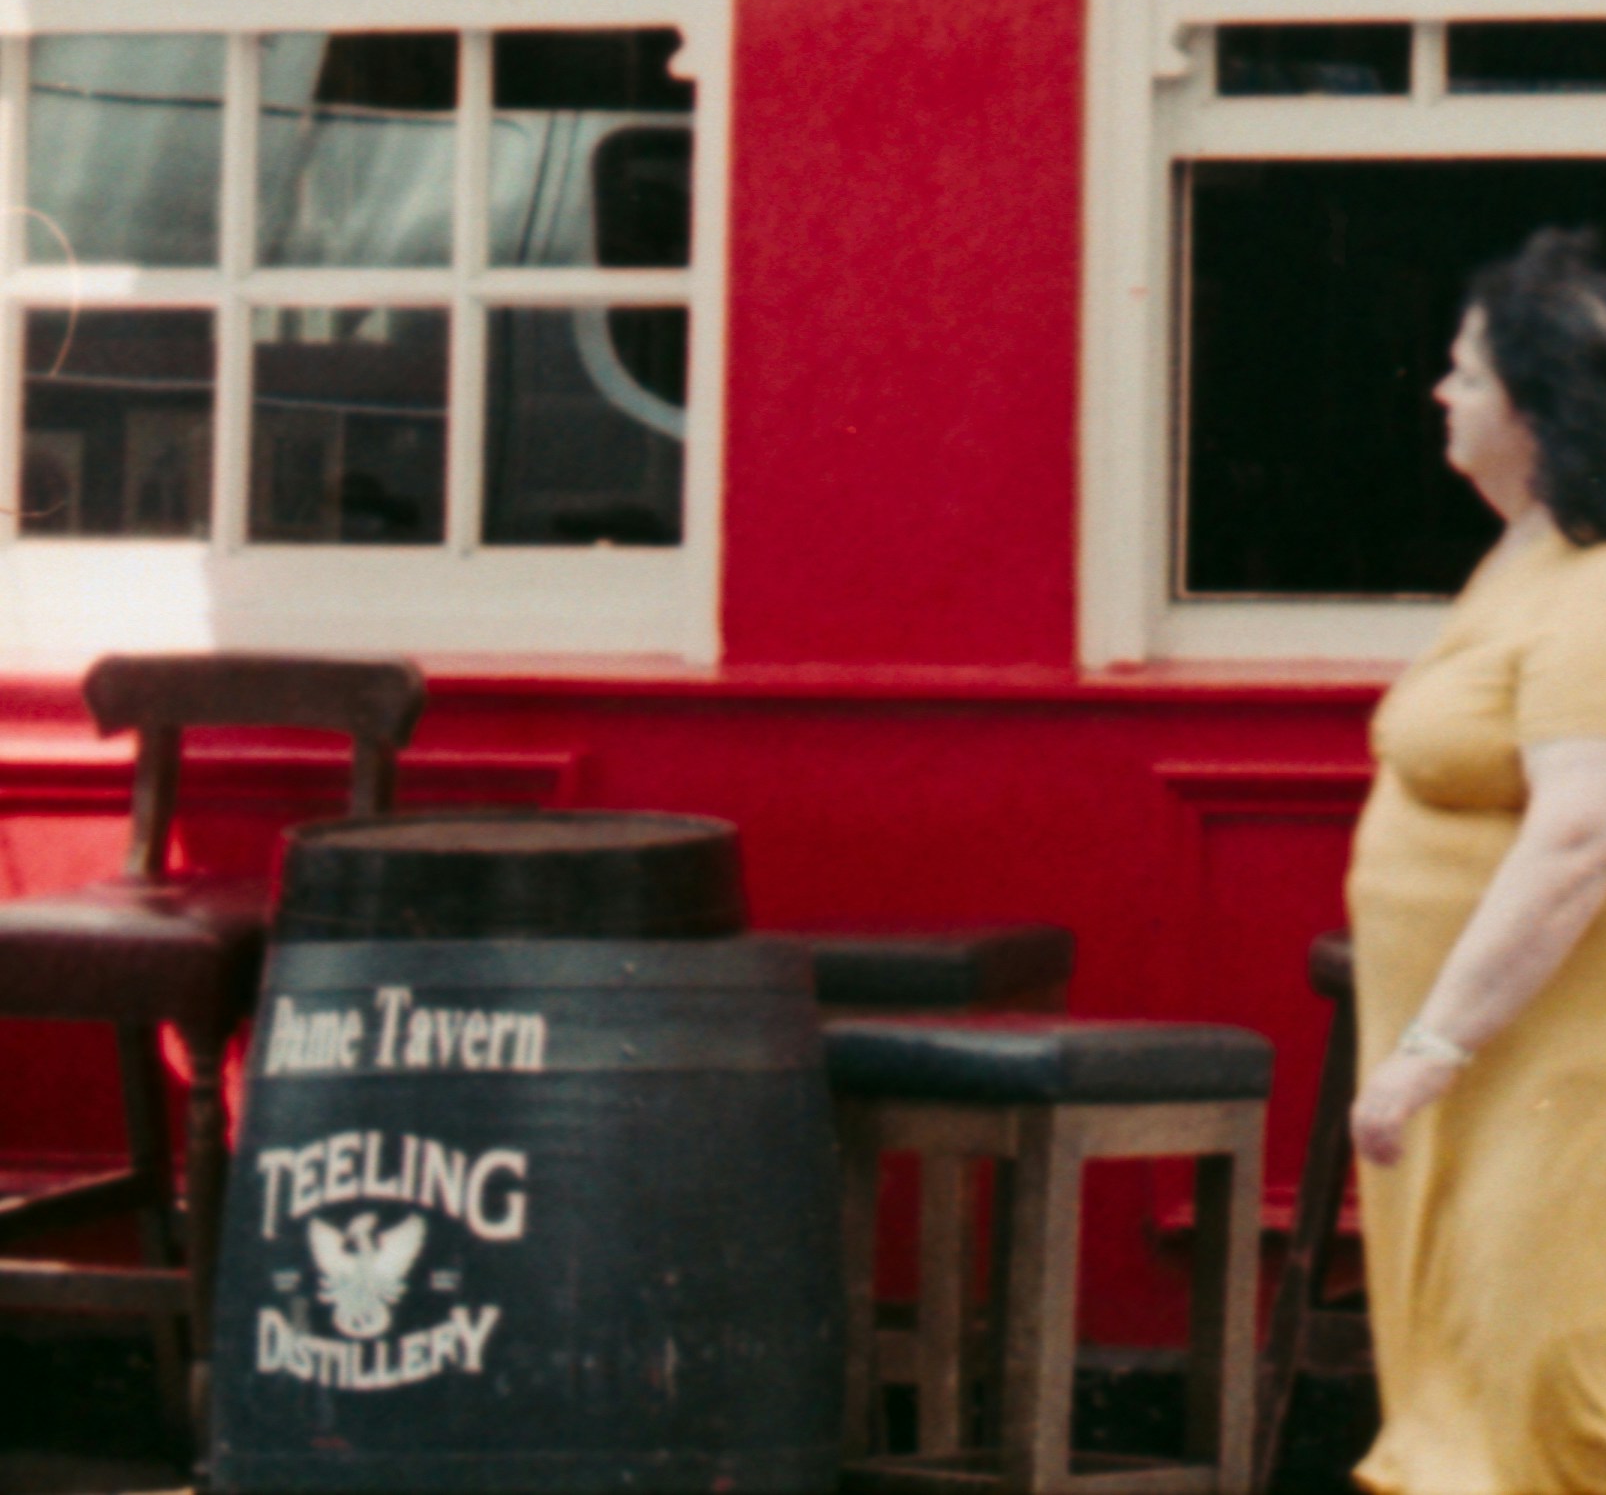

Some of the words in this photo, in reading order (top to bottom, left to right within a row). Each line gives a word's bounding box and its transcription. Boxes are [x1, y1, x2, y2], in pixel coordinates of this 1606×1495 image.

[375, 985, 548, 1072] Tavern
[257, 1129, 528, 1242] TEELING
[256, 1303, 500, 1392] DISTILLERY
